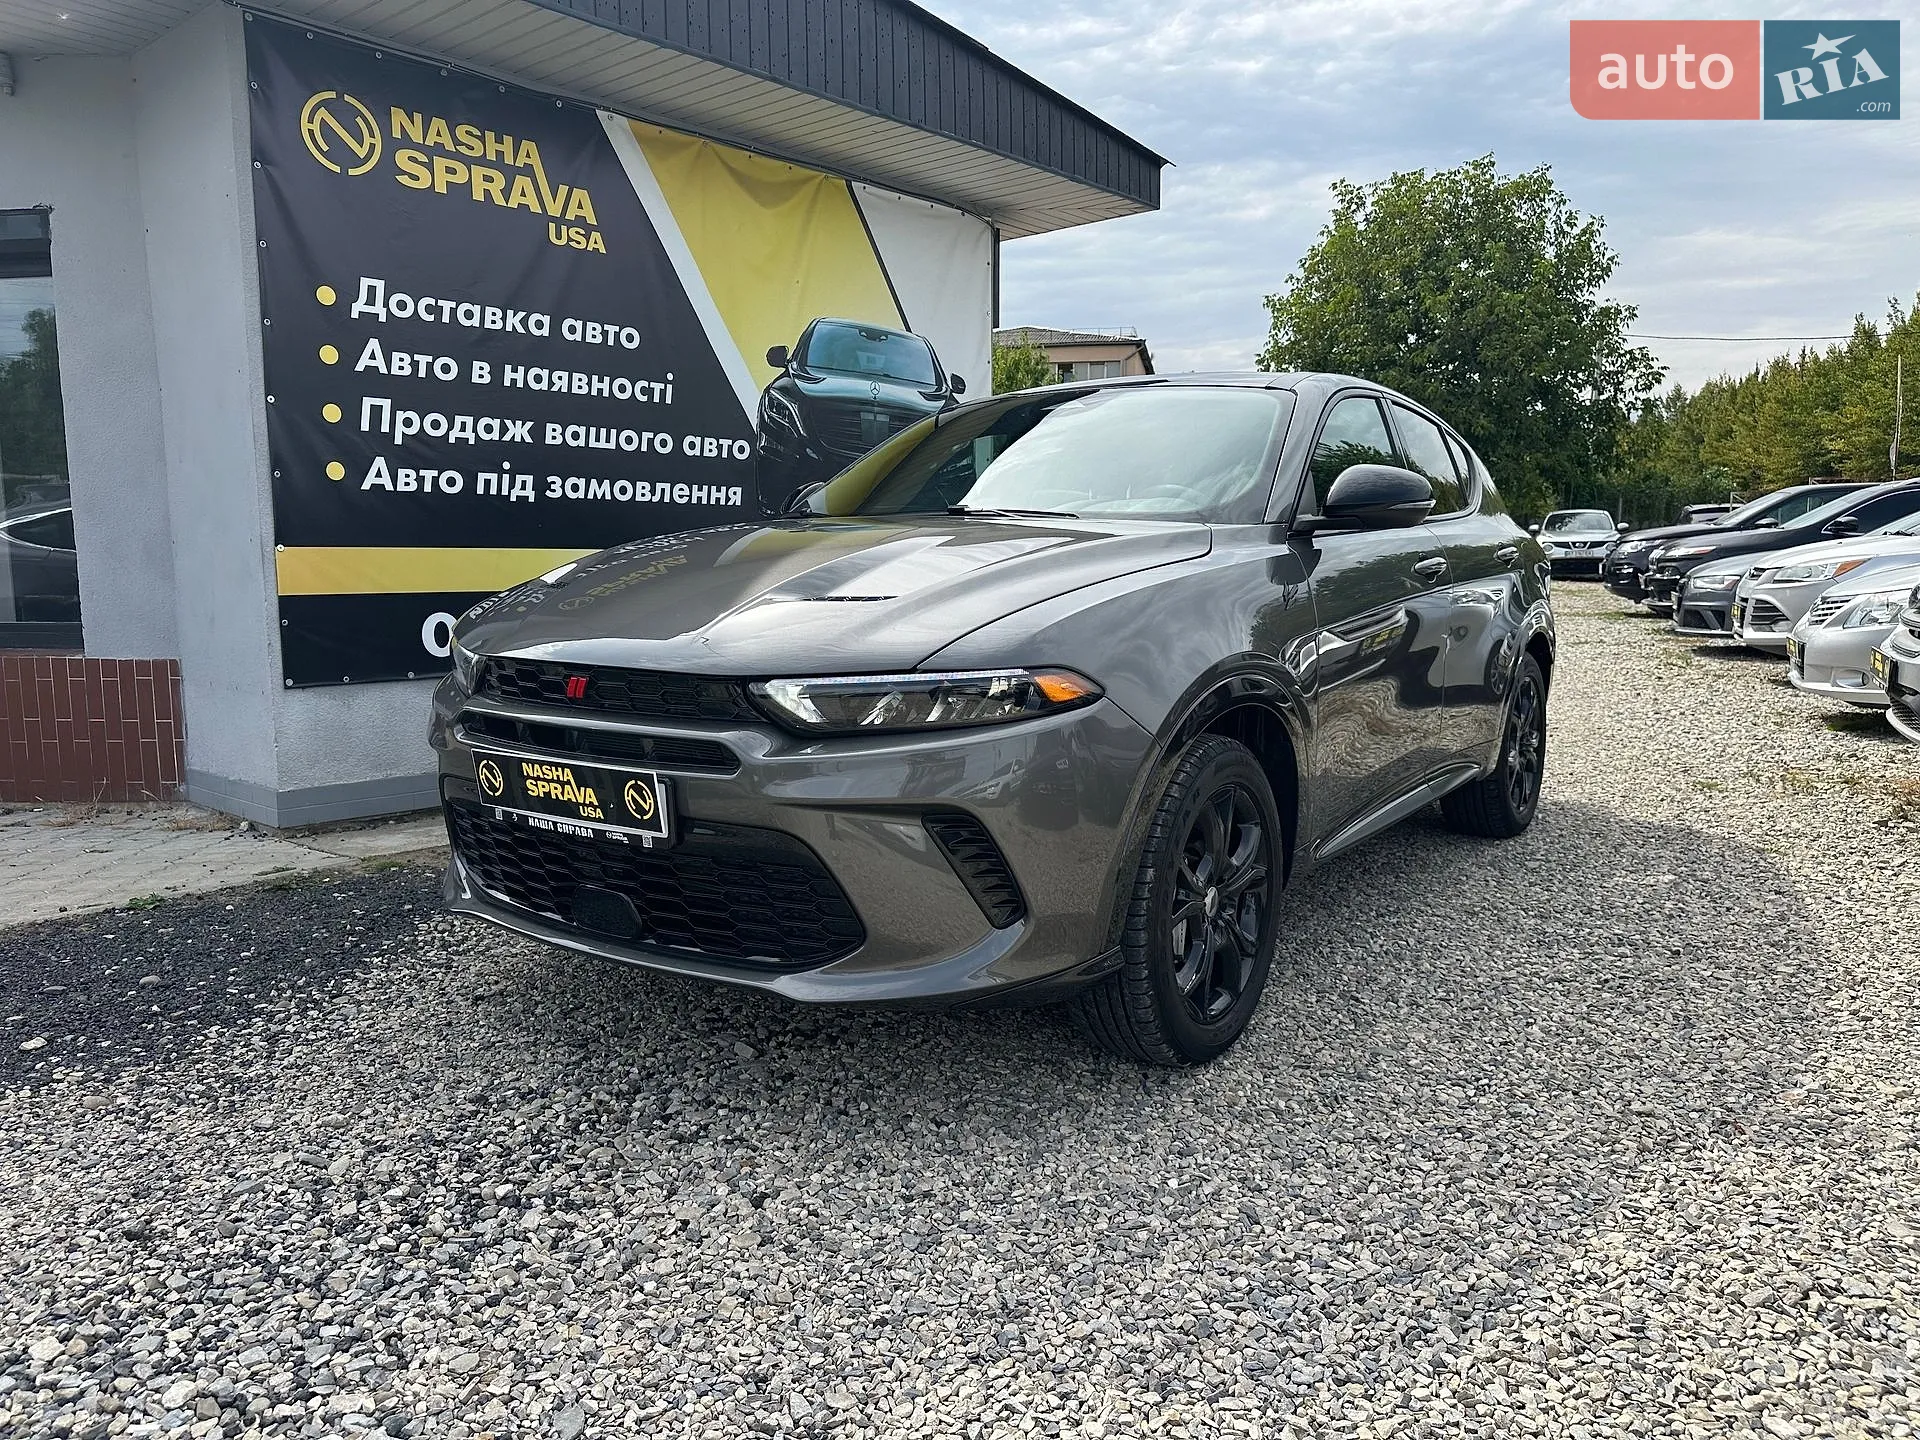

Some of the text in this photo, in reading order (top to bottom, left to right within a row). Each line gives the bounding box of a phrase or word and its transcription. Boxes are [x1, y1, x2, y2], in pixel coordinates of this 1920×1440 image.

[391, 107, 540, 169] NASHA
[395, 146, 598, 226] SPRAVA
[548, 221, 607, 254] USA
[350, 276, 641, 350] Доставка авто
[354, 337, 674, 405] Авто в наявності
[360, 396, 751, 461] Продаж вашого авто
[360, 456, 743, 506] Авто під замовлення
[521, 762, 573, 782] NASHA
[525, 778, 599, 806] SPRAVA
[557, 823, 594, 838] СПРАВА
[579, 805, 605, 820] USA
